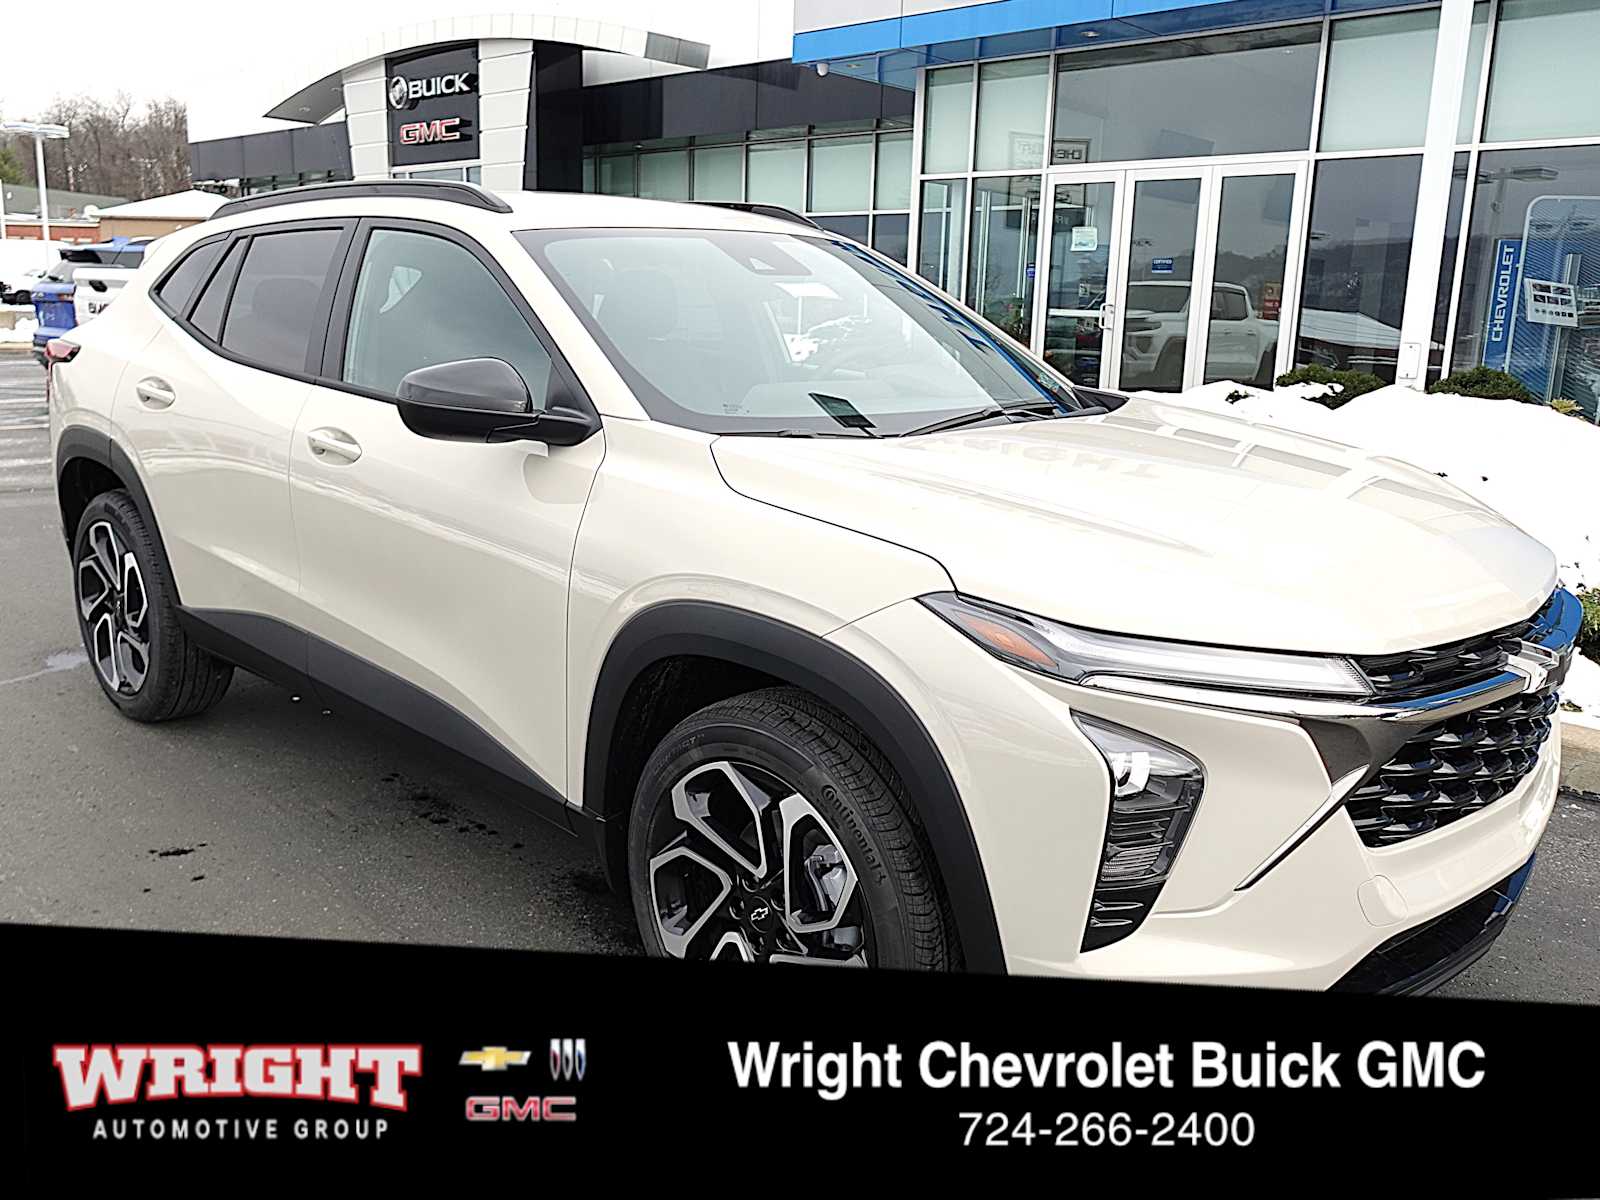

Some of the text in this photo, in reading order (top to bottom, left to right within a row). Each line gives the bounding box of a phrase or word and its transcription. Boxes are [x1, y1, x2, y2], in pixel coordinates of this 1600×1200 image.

[408, 72, 471, 99] BUICK
[400, 117, 460, 144] GMC
[1491, 245, 1515, 342] CHEVROLET
[821, 784, 882, 870] Continental
